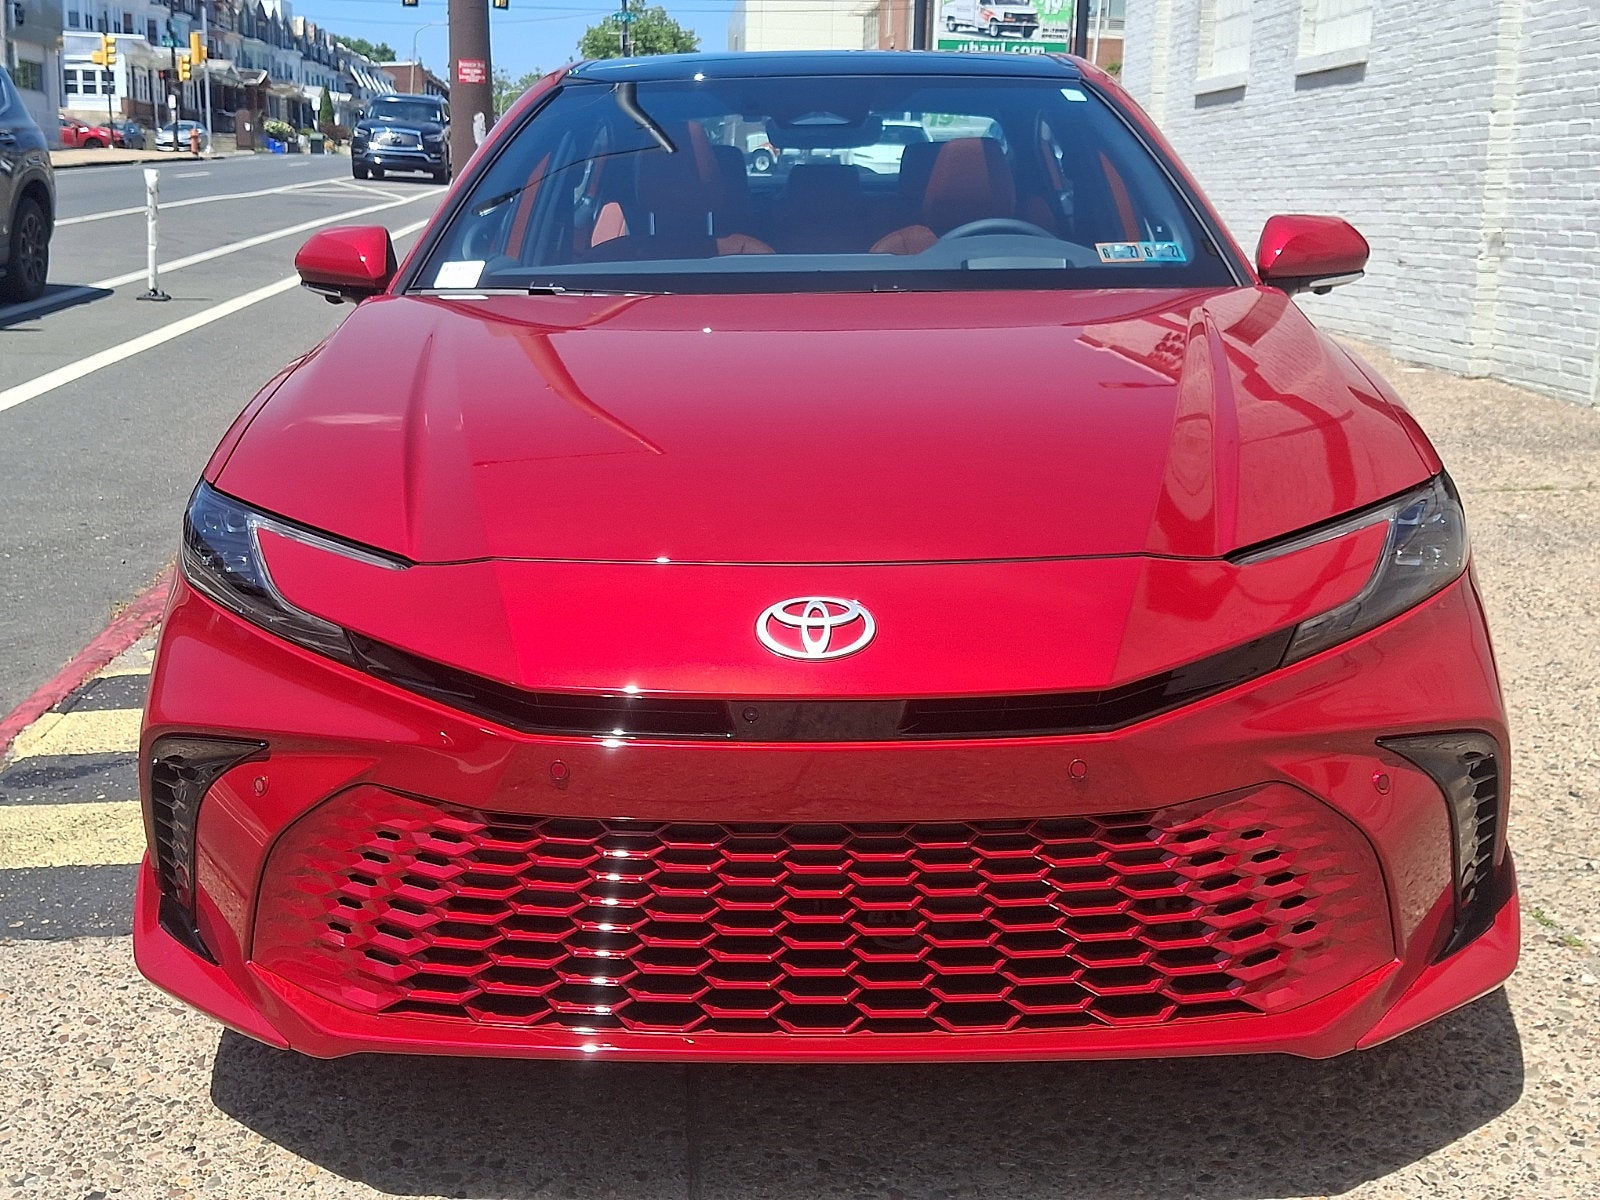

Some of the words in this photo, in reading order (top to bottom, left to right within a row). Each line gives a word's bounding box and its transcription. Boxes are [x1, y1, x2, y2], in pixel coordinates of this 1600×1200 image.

[957, 41, 1046, 55] uhaul.com
[1102, 247, 1111, 259] 6
[1144, 246, 1154, 258] 6
